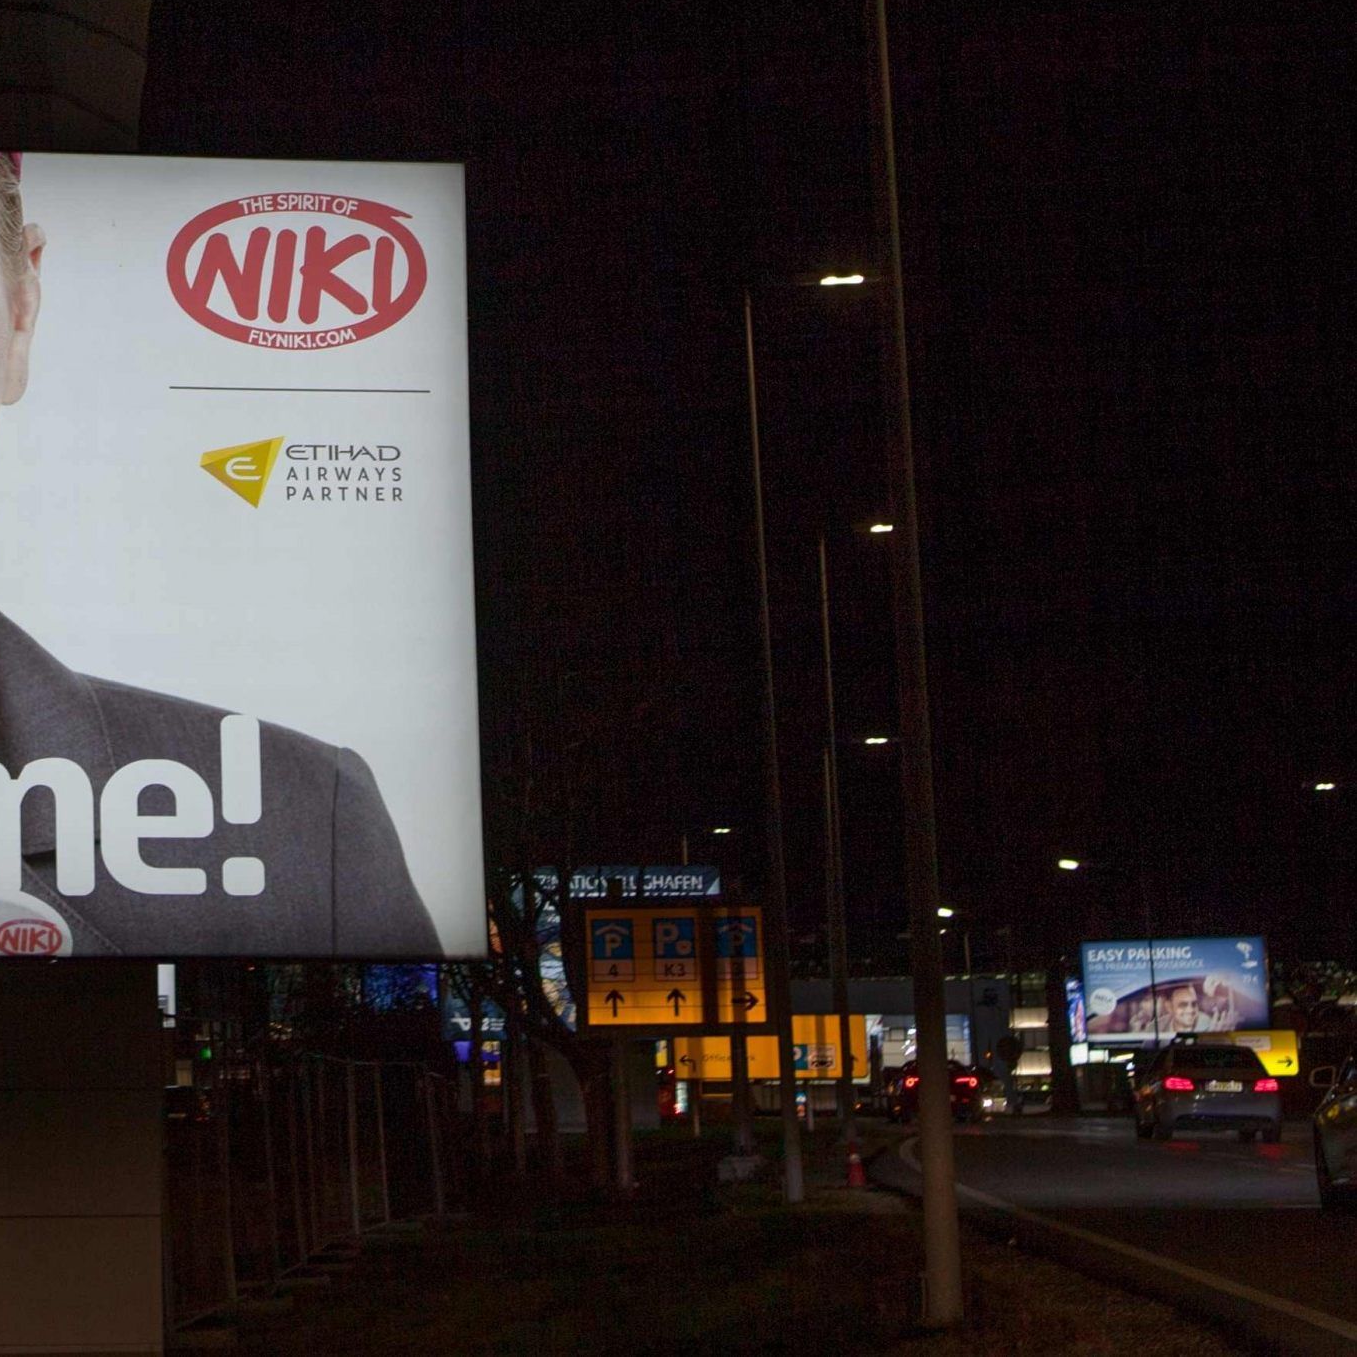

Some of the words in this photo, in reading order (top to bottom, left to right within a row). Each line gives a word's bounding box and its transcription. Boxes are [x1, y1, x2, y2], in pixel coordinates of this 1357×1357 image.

[239, 194, 274, 215] THE
[277, 194, 331, 211] SPIRIT
[332, 198, 359, 215] OF
[191, 225, 395, 325] NIKI
[248, 329, 357, 349] FLYNIKI.COM
[285, 444, 401, 461] ETIHAD
[286, 467, 402, 481] AIRWAYS
[286, 486, 403, 501] PARTNER
[1, 927, 54, 953] NIKI
[1088, 948, 1124, 962] EASY
[1127, 946, 1191, 960] PARKING
[609, 964, 618, 977] 4
[664, 963, 686, 977] K3
